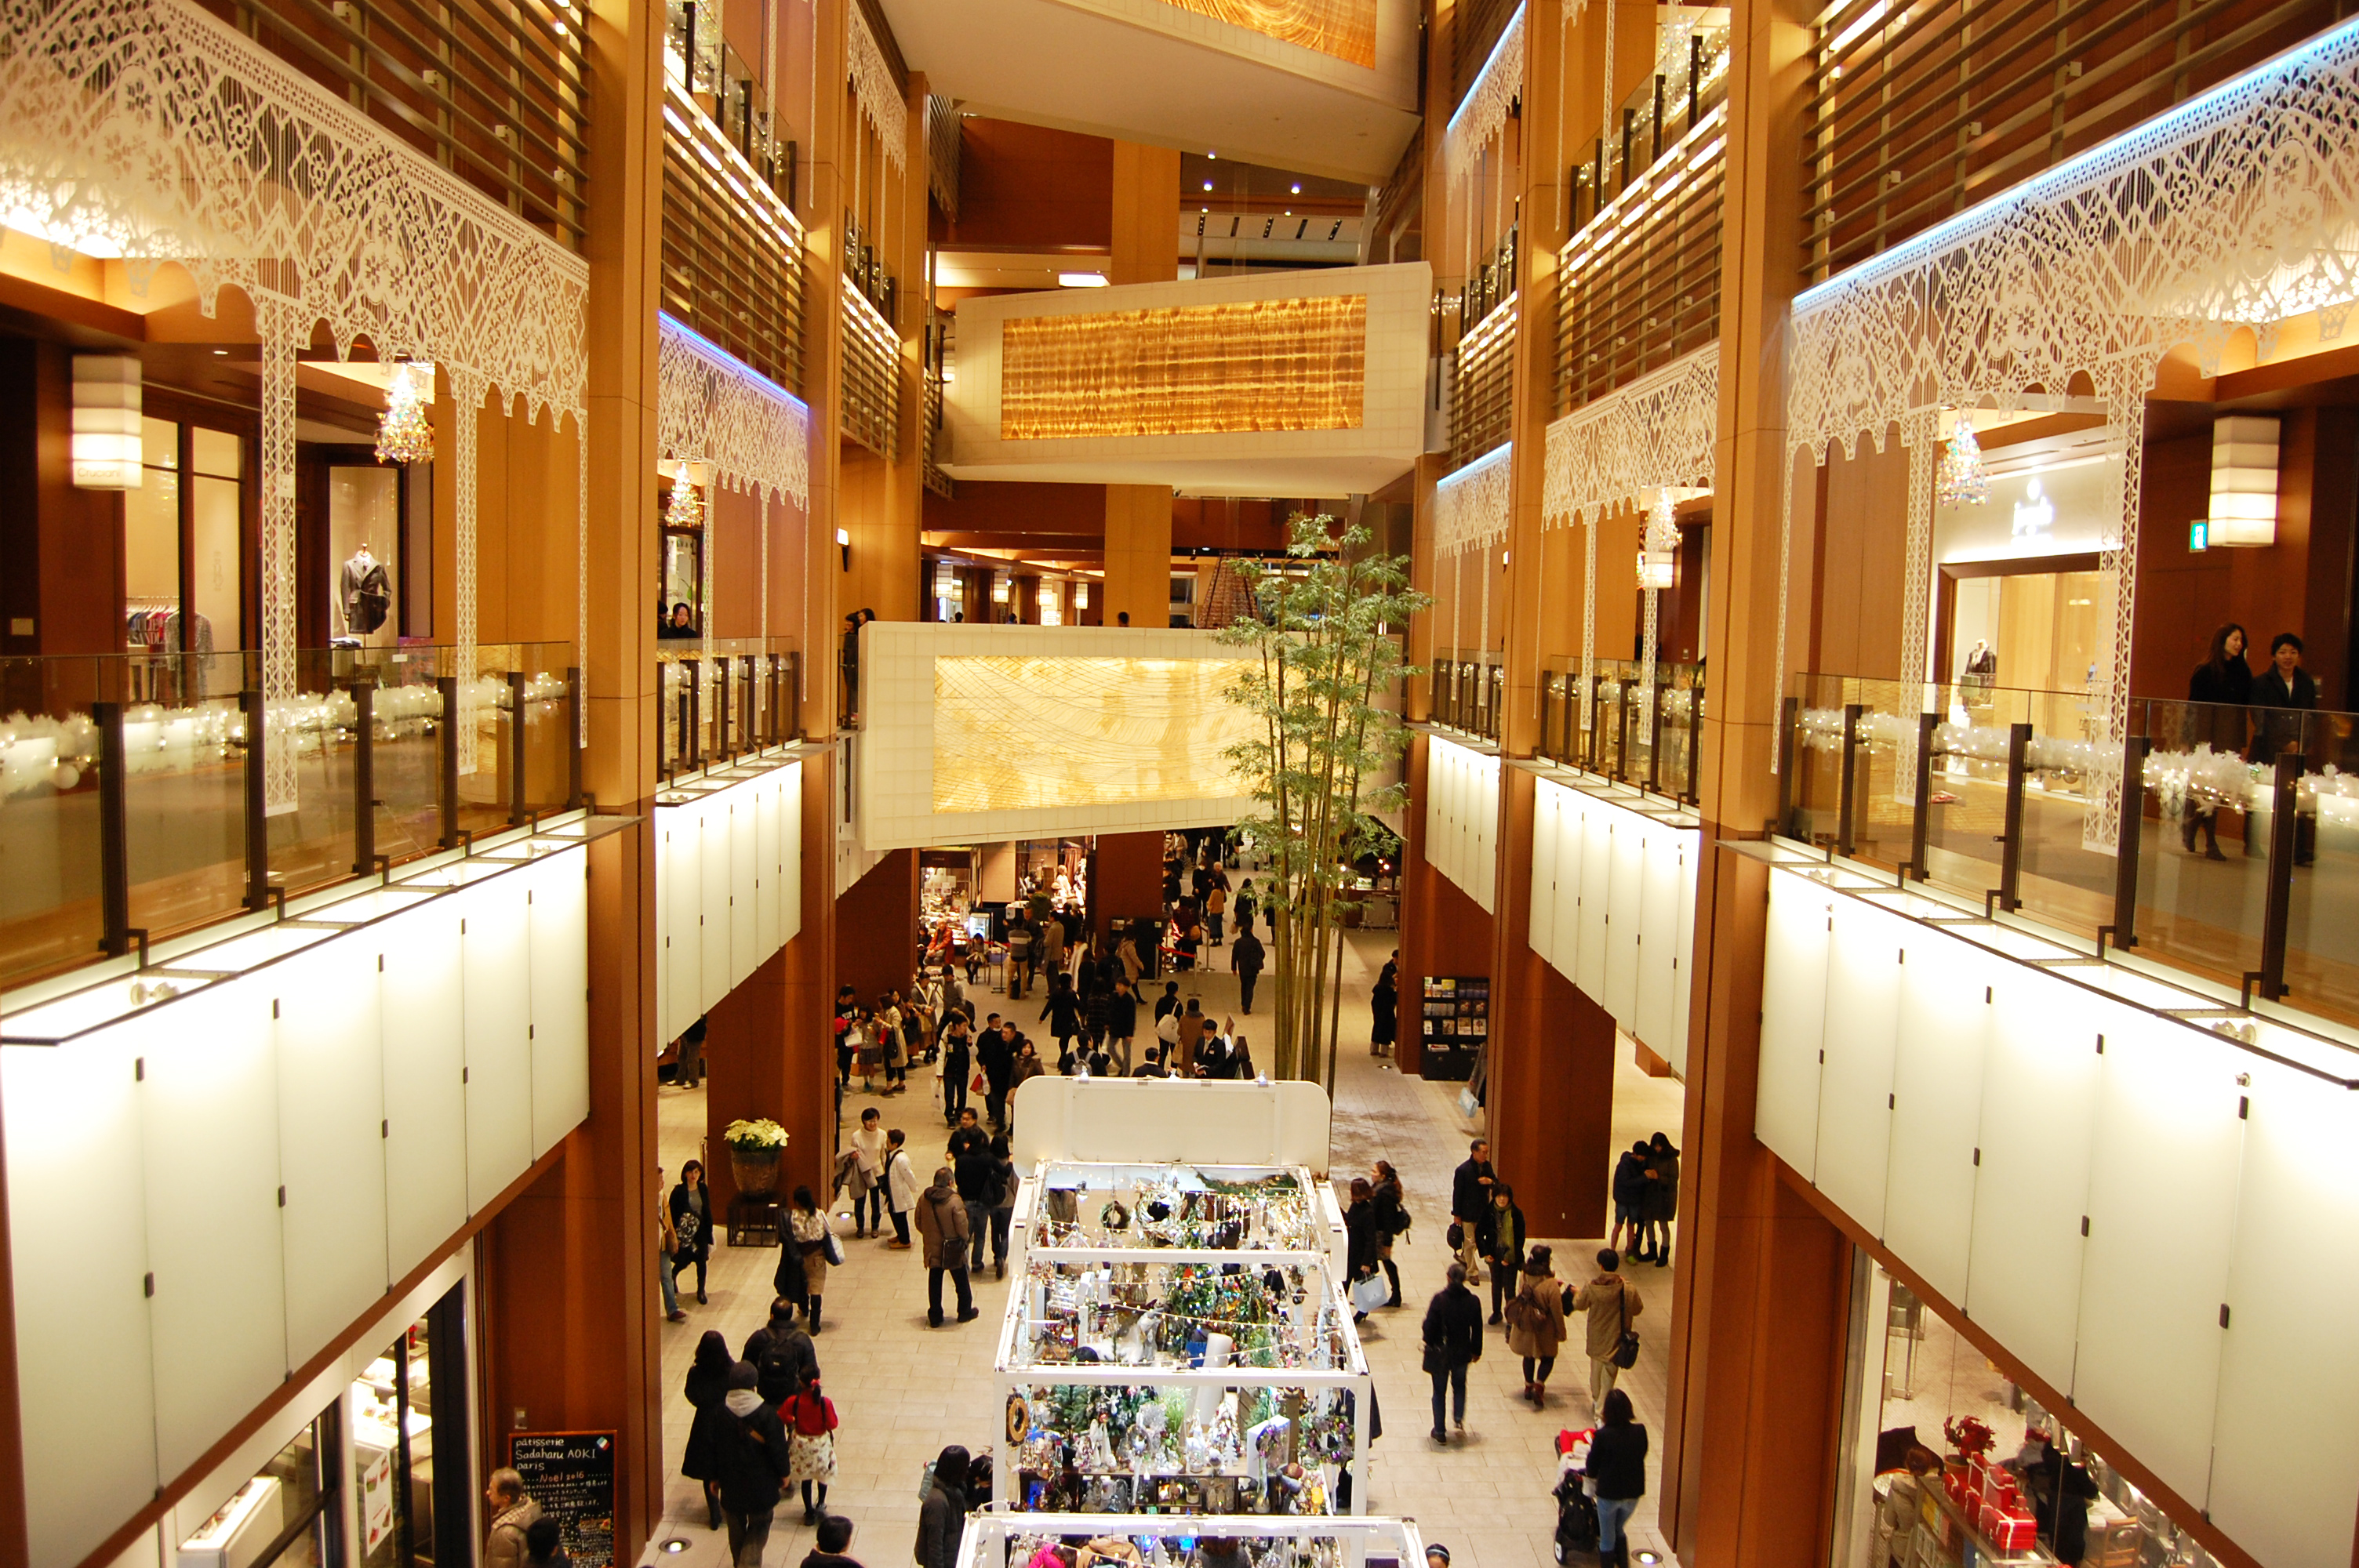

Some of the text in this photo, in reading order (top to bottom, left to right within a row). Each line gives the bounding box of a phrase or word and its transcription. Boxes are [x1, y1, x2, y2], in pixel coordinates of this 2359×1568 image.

[77, 467, 121, 477] Cruciani
[515, 1447, 596, 1460] Sadaharu AOKI
[517, 1461, 545, 1471] paris
[565, 1471, 584, 1481] 2016
